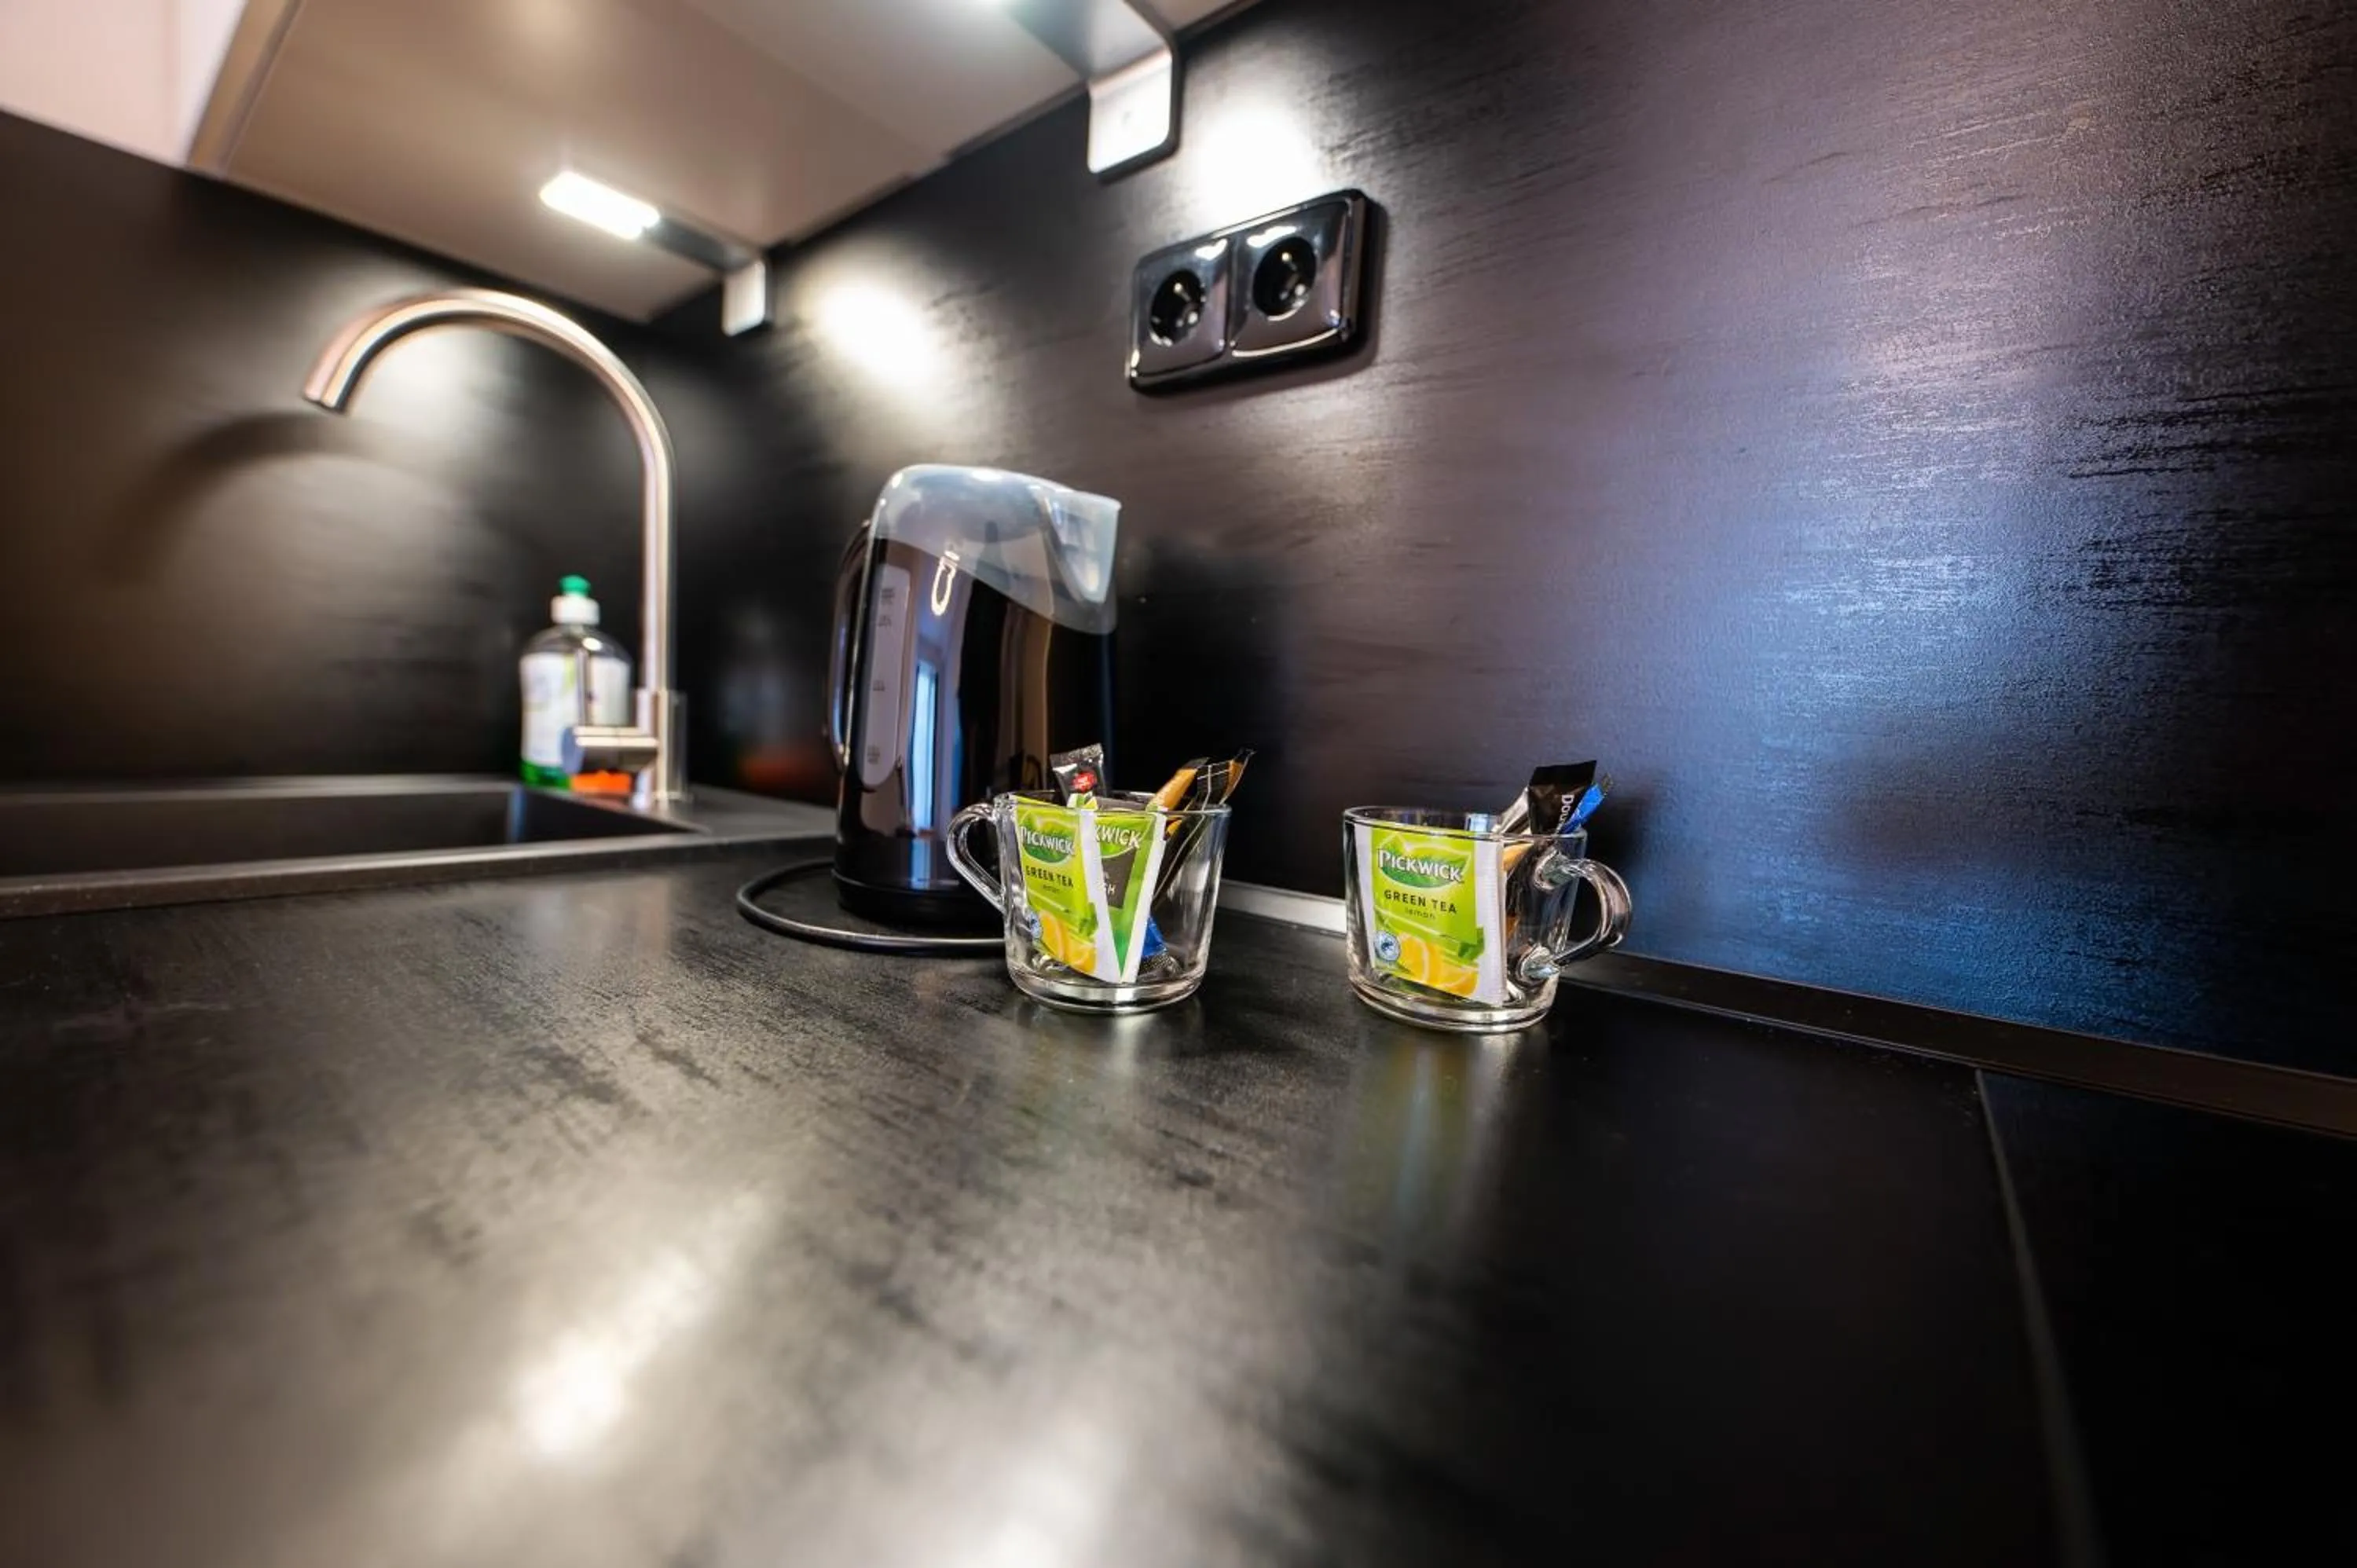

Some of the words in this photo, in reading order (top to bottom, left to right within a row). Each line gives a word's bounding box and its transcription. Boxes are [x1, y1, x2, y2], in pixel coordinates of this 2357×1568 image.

[1025, 865, 1054, 882] GREEN
[1055, 874, 1074, 888] TEA
[1377, 848, 1464, 884] PICKWICK
[1384, 889, 1427, 907] GREEN
[1431, 898, 1457, 914] TEA
